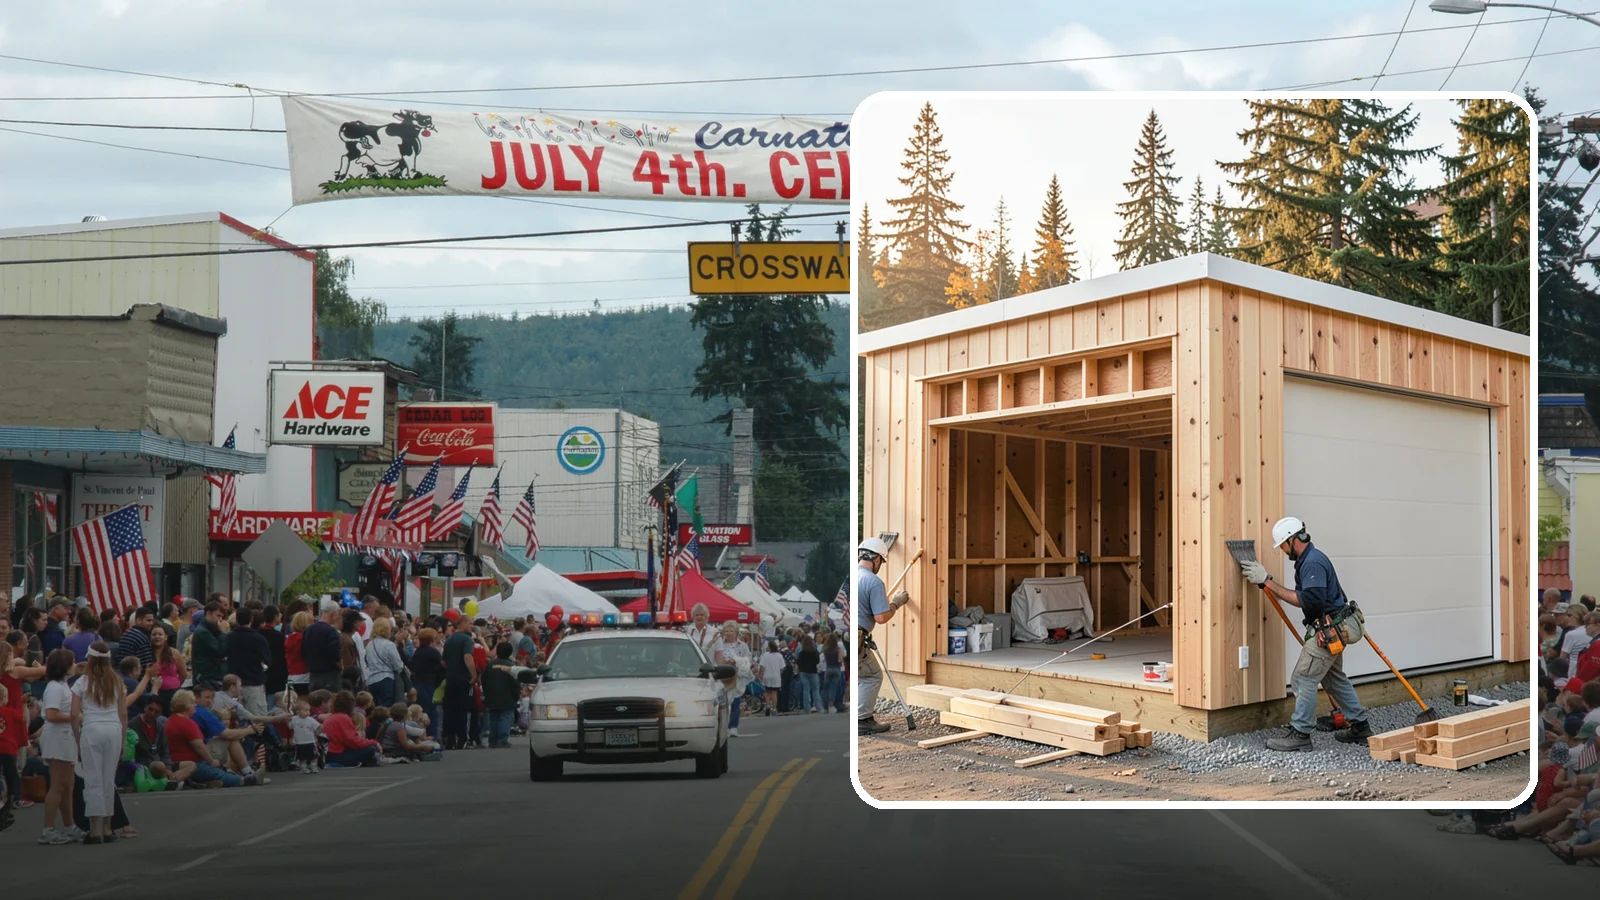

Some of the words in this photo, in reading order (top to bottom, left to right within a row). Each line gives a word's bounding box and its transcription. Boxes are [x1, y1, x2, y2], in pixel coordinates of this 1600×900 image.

[695, 121, 850, 149] Carnat
[481, 141, 605, 193] JULY
[632, 150, 746, 197] 4th.
[696, 254, 850, 280] CROSSWA
[283, 380, 373, 420] ACE
[406, 409, 452, 421] CEDAR
[461, 409, 485, 421] LOG
[283, 421, 371, 436] Hardware
[416, 428, 477, 447] Coca-Cola
[353, 467, 385, 480] Simpl
[83, 485, 93, 494] St.
[95, 485, 124, 495] Vincent
[127, 485, 136, 495] de
[138, 485, 155, 495] Paul
[81, 503, 154, 521] THT
[212, 516, 331, 535] HRDARE
[688, 526, 741, 535] CRNATION
[699, 535, 730, 543] GLASS
